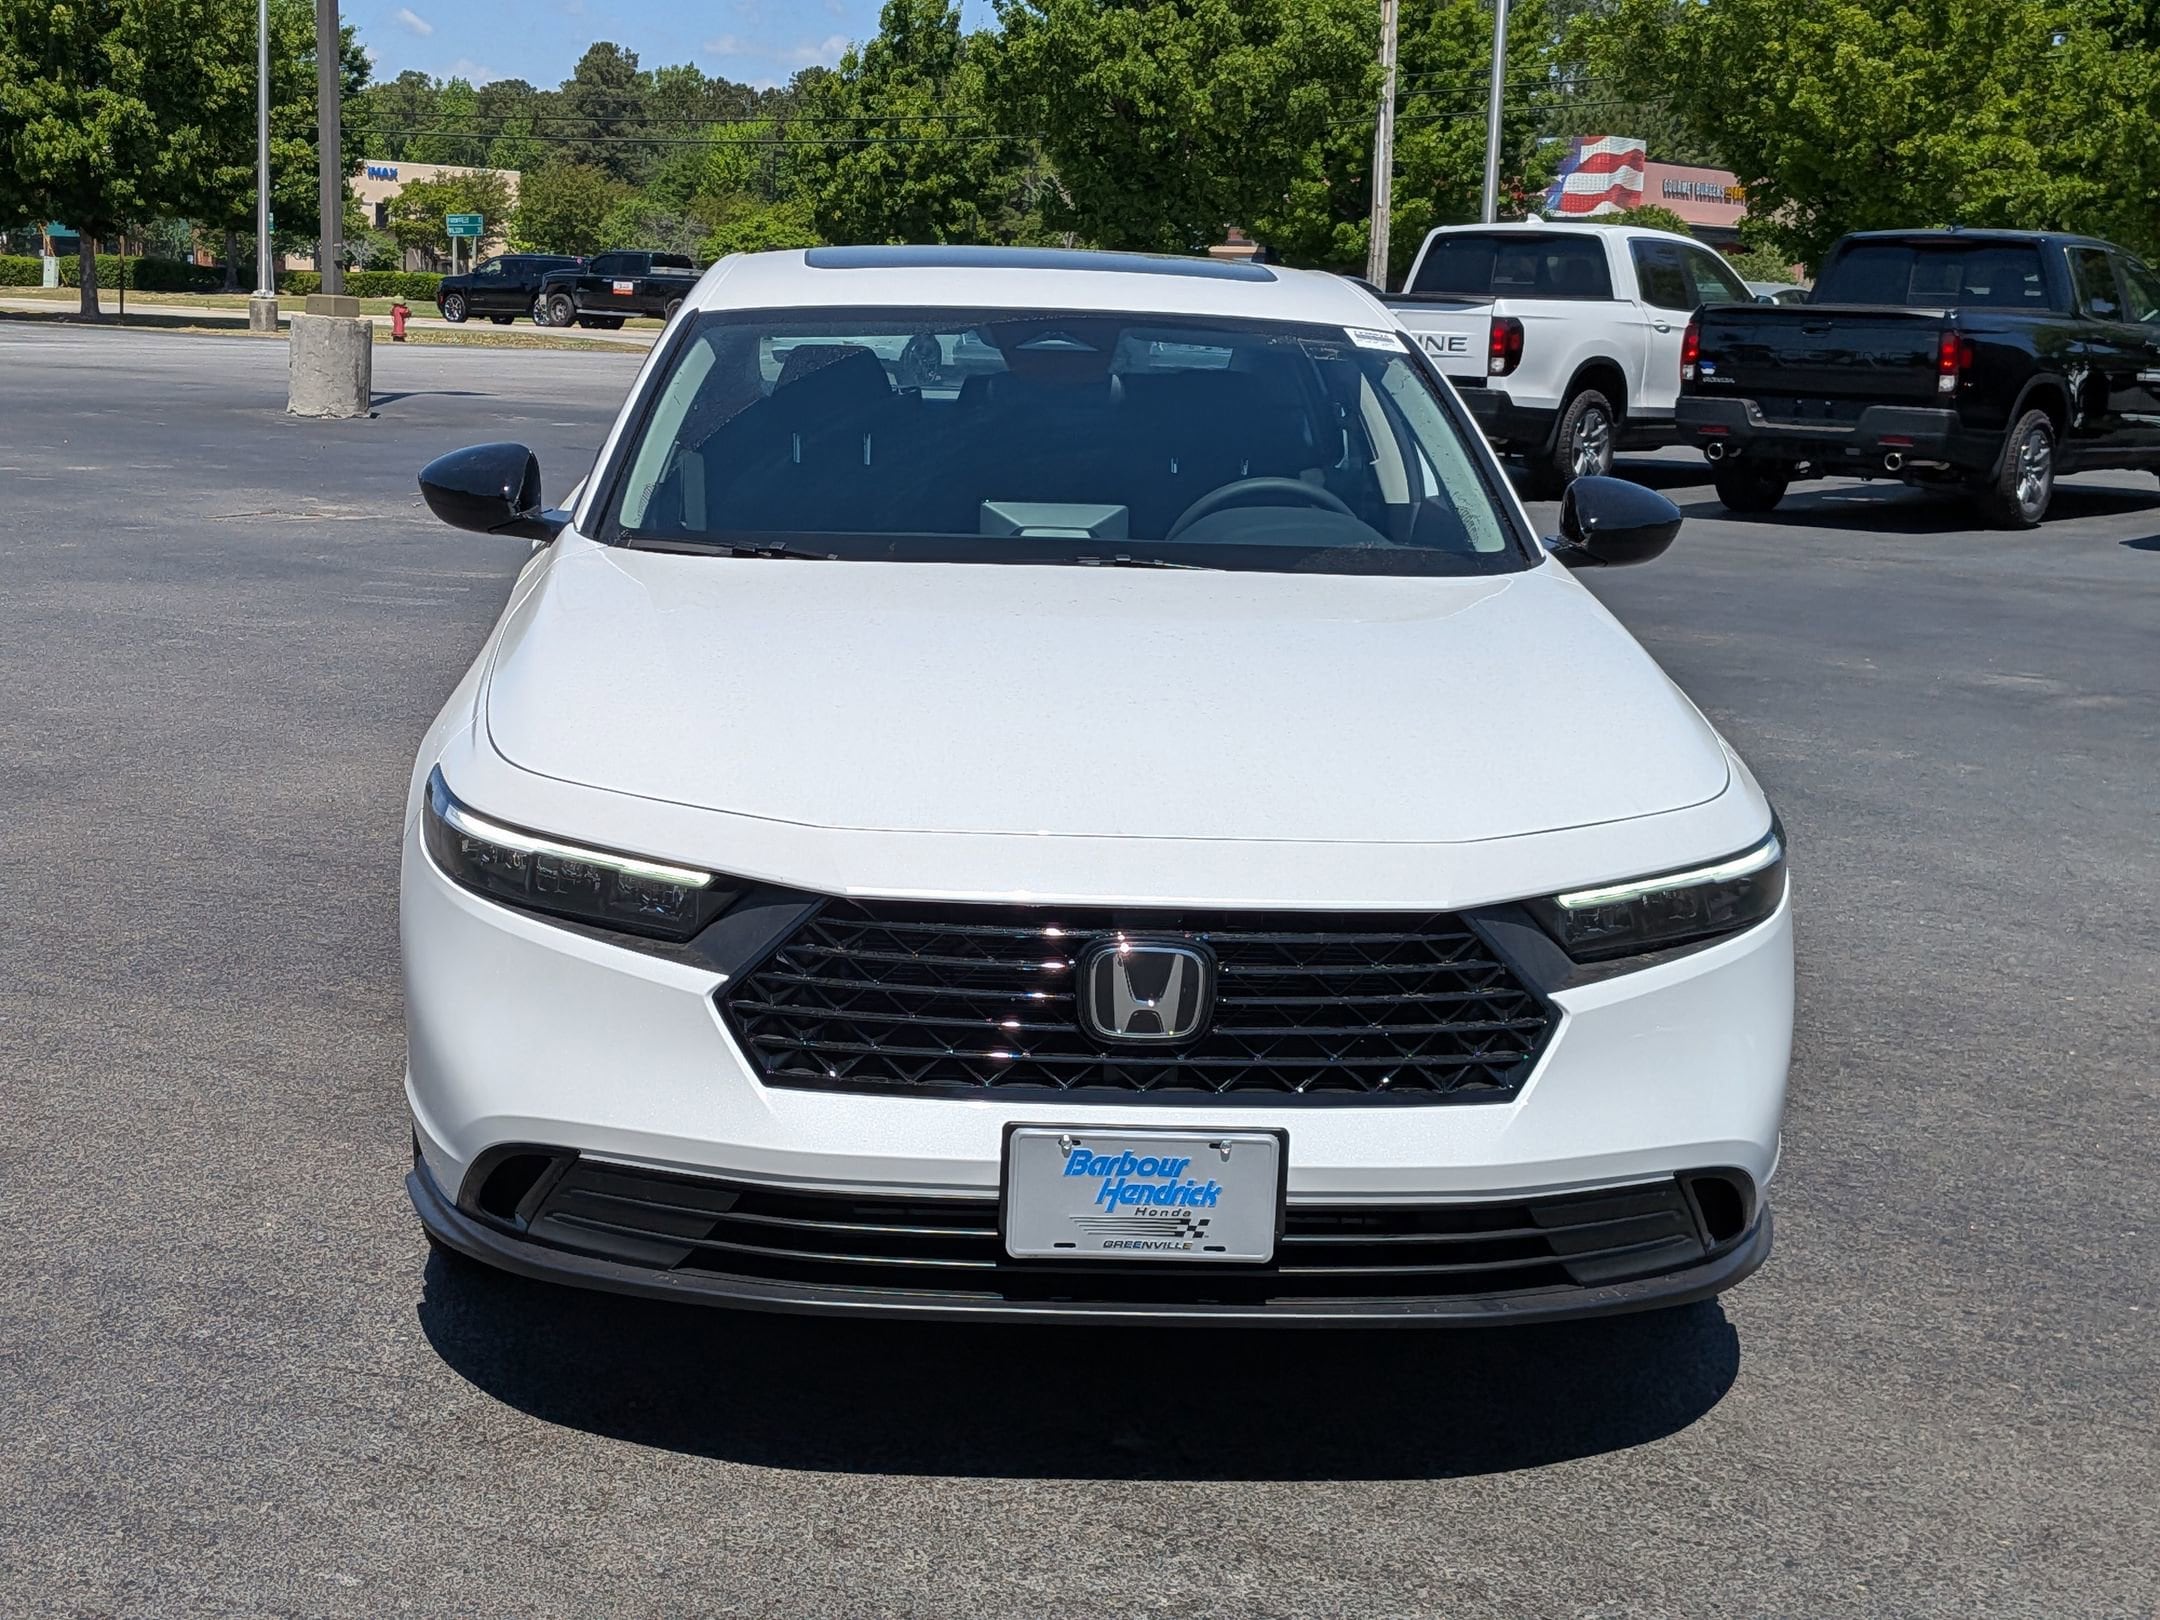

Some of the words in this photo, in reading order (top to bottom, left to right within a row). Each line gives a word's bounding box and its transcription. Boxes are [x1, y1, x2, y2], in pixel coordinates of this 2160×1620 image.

[1063, 1147, 1192, 1178] Barbour
[1095, 1177, 1223, 1213] Hendrick
[1134, 1207, 1192, 1217] Honda
[1103, 1240, 1193, 1250] GREENVILLE
